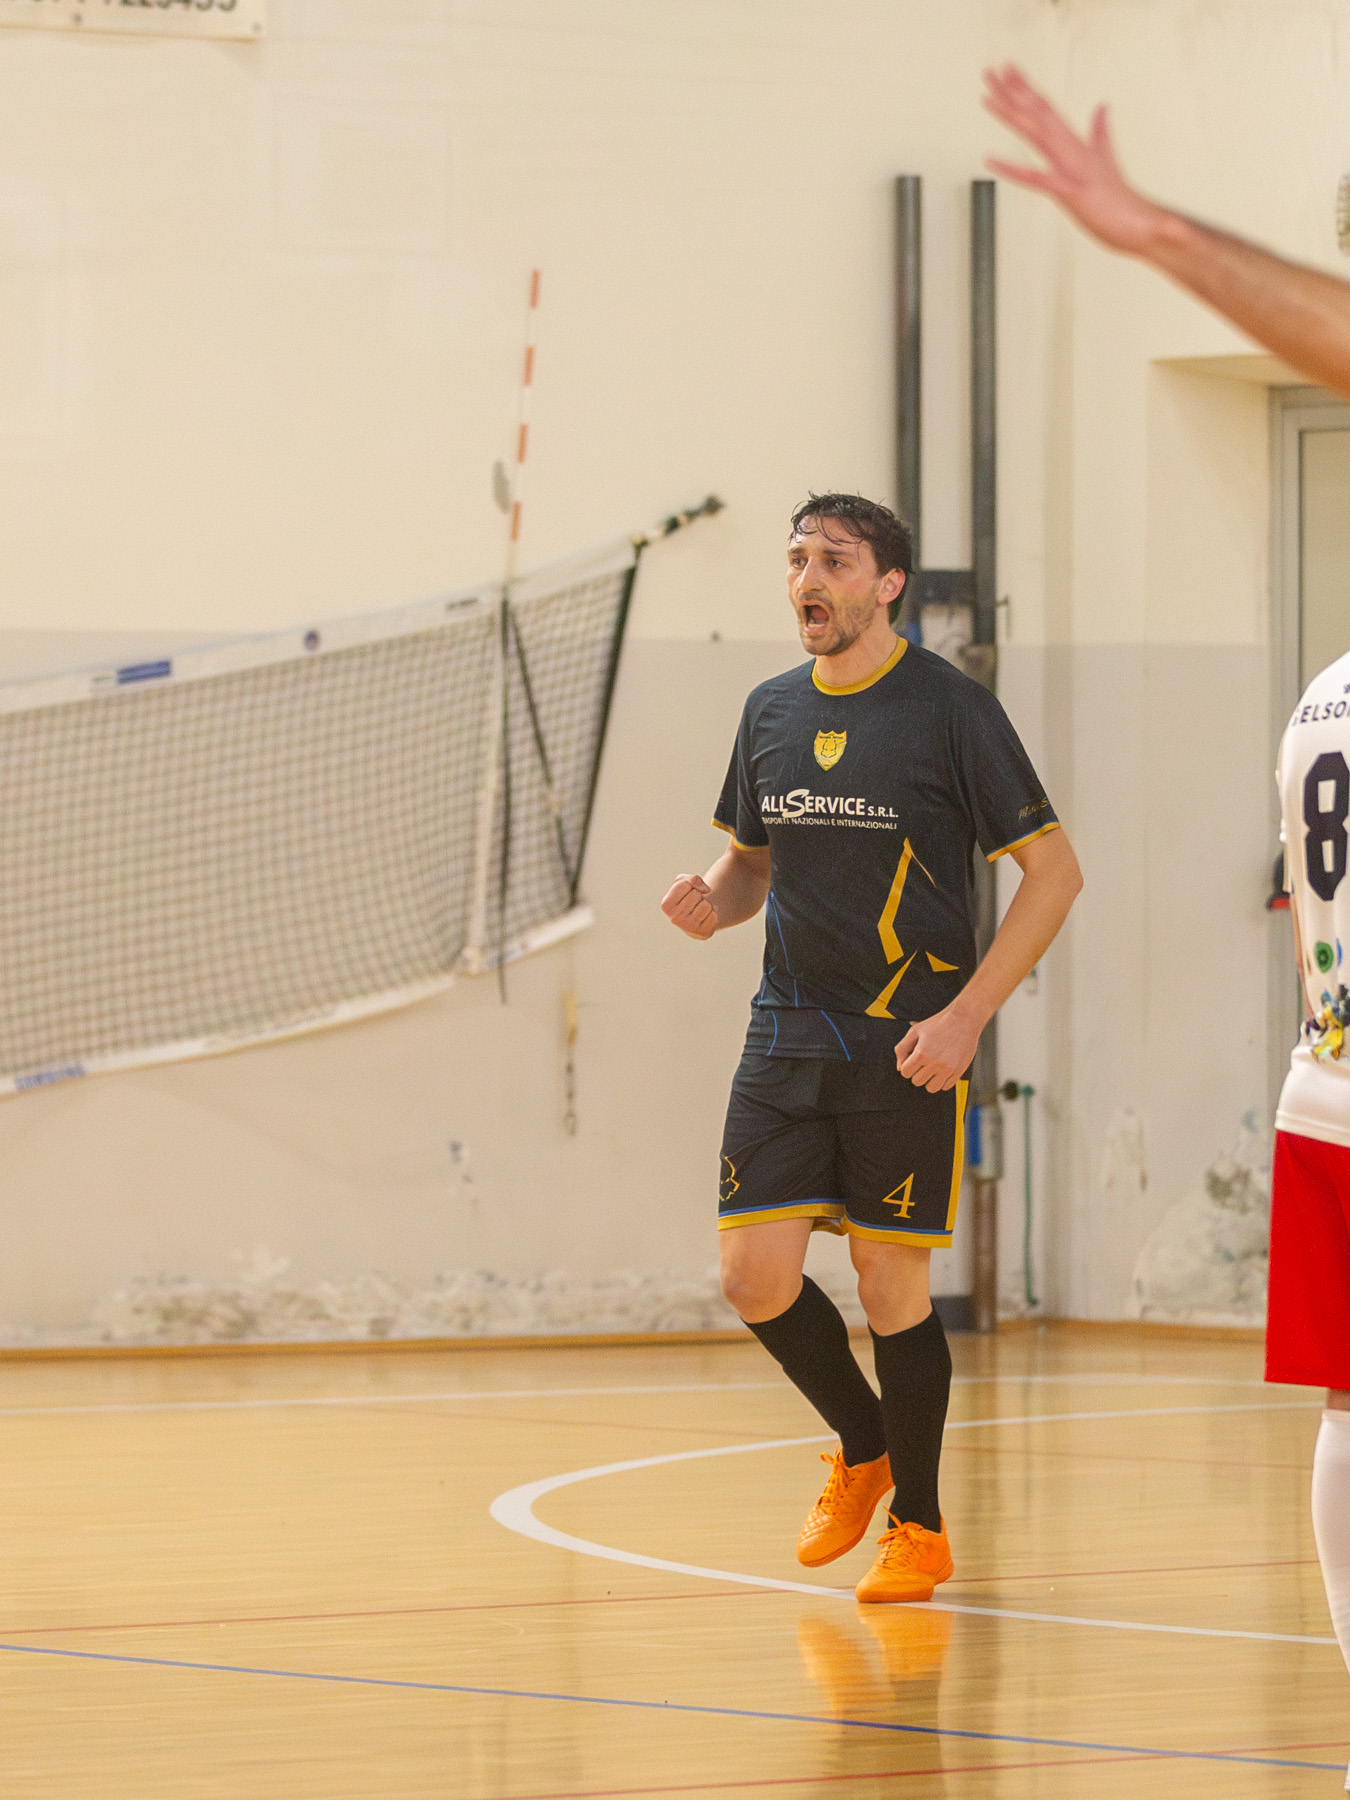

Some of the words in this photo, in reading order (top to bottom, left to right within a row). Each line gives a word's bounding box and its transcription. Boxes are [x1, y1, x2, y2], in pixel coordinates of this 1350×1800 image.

[791, 817, 831, 826] NAZIONALI
[831, 818, 837, 827] E
[837, 819, 897, 830] INTERNAZIONALI
[867, 805, 899, 818] S.R.L.
[1303, 750, 1350, 901] 8
[882, 1172, 915, 1218] 4
